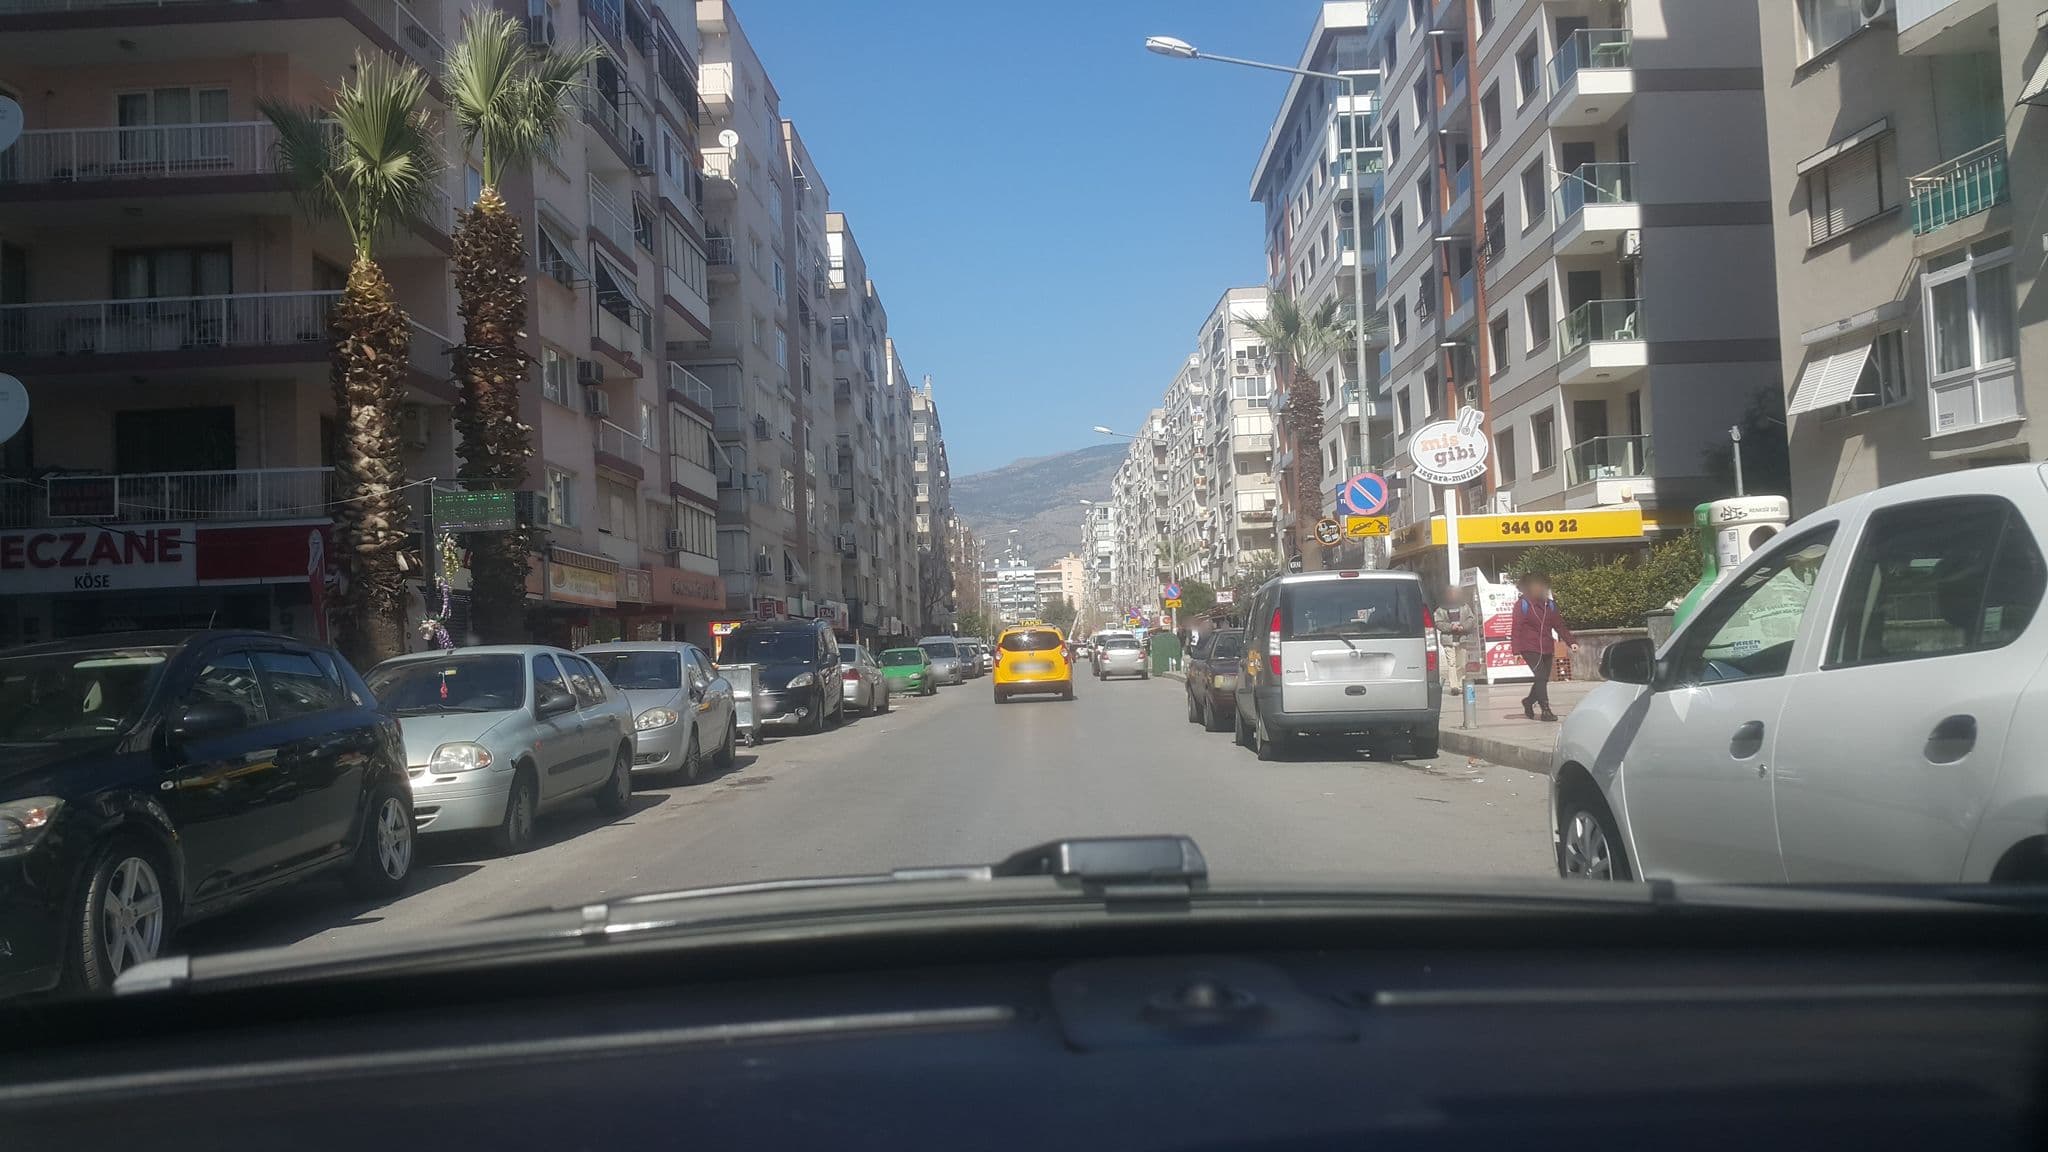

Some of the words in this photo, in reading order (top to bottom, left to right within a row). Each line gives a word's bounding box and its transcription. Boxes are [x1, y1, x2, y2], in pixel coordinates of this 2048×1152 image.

[1421, 433, 1458, 452] mis
[1434, 443, 1476, 467] gibi
[1501, 521, 1530, 534] 344
[1535, 520, 1554, 533] 00
[1559, 519, 1578, 532] 22
[1, 528, 183, 569] ECZANE
[74, 573, 110, 589] KÖSE
